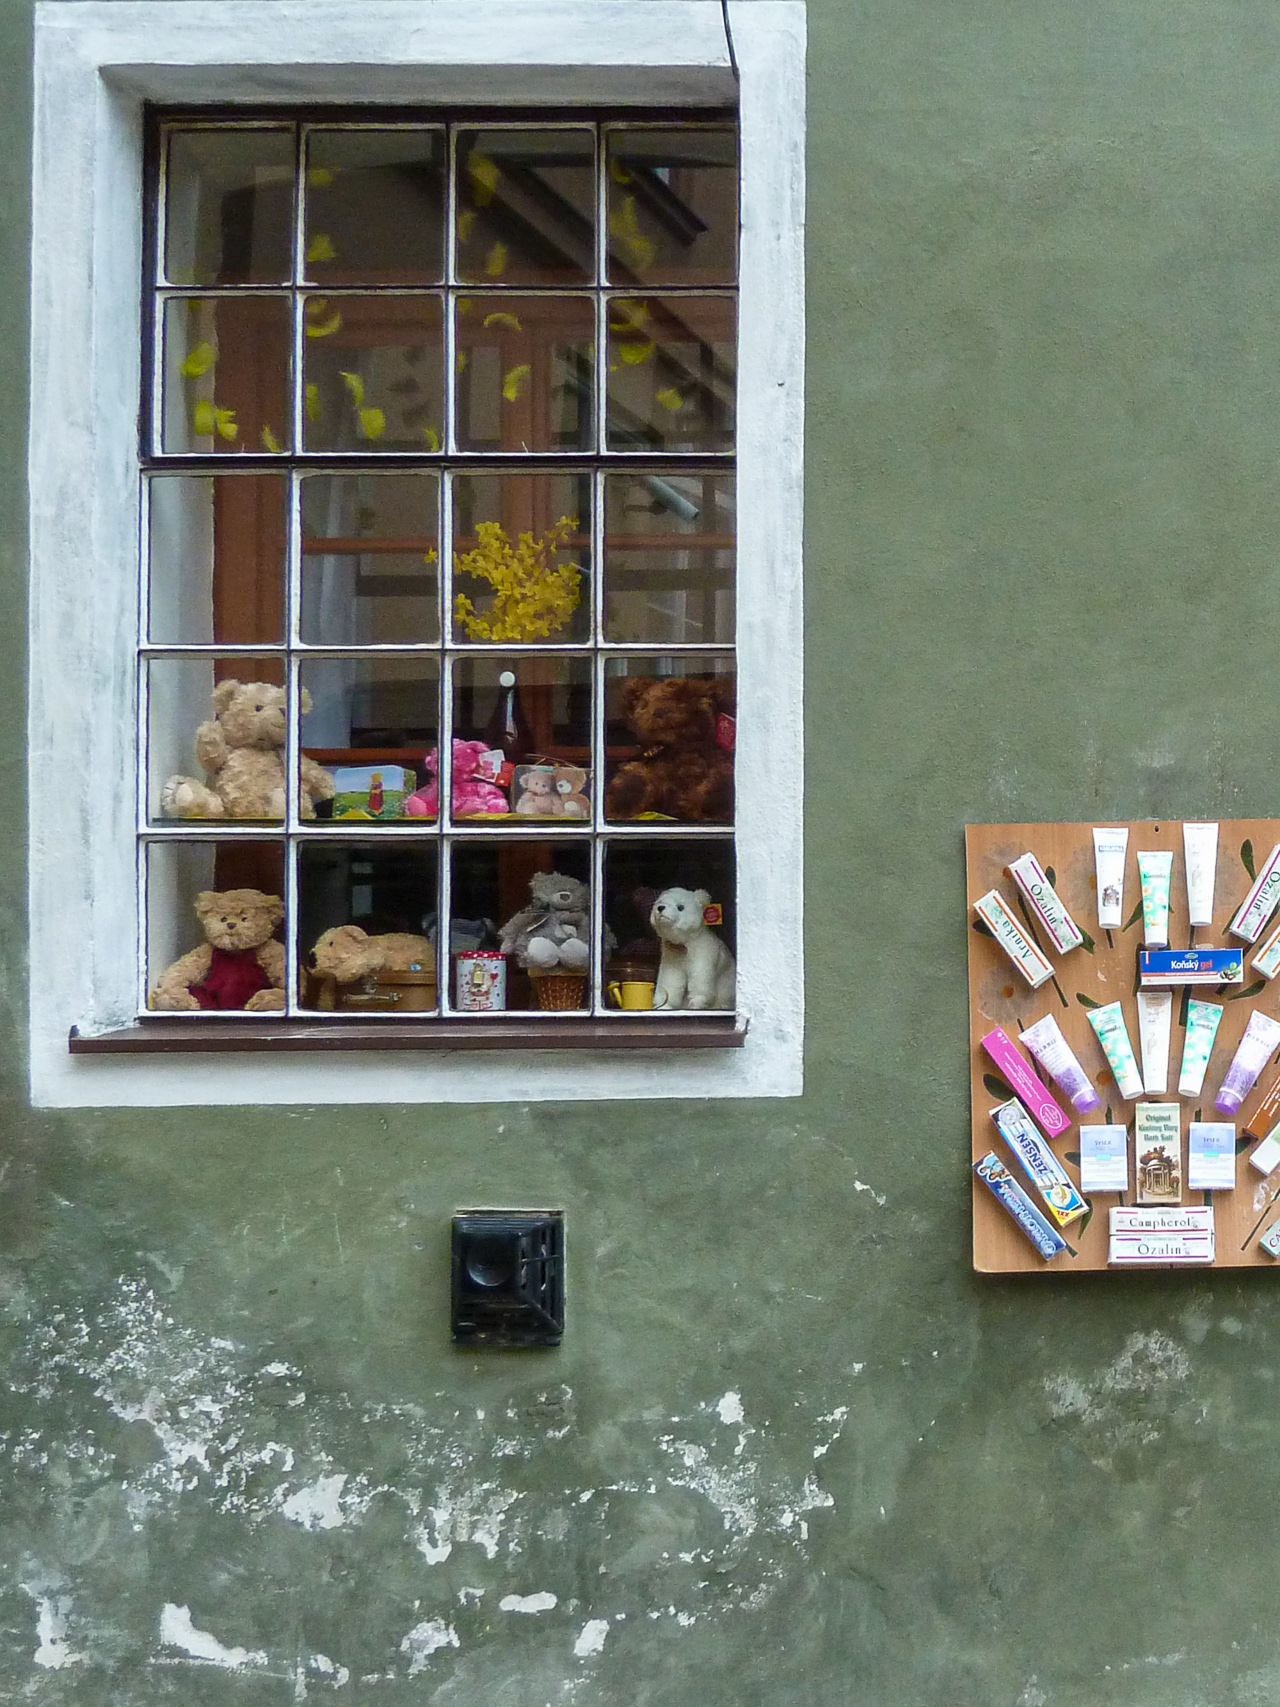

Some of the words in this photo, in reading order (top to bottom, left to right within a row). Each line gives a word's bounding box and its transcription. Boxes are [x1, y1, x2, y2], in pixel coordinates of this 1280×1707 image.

[1030, 883, 1058, 925] Ozalin
[1253, 871, 1280, 910] Ozalin
[1002, 920, 1033, 959] Arnika
[1171, 959, 1199, 970] Koňský
[1016, 1132, 1050, 1176] ZENSEN
[1129, 1217, 1191, 1230] Campherol
[1137, 1243, 1182, 1255] Ozalin
